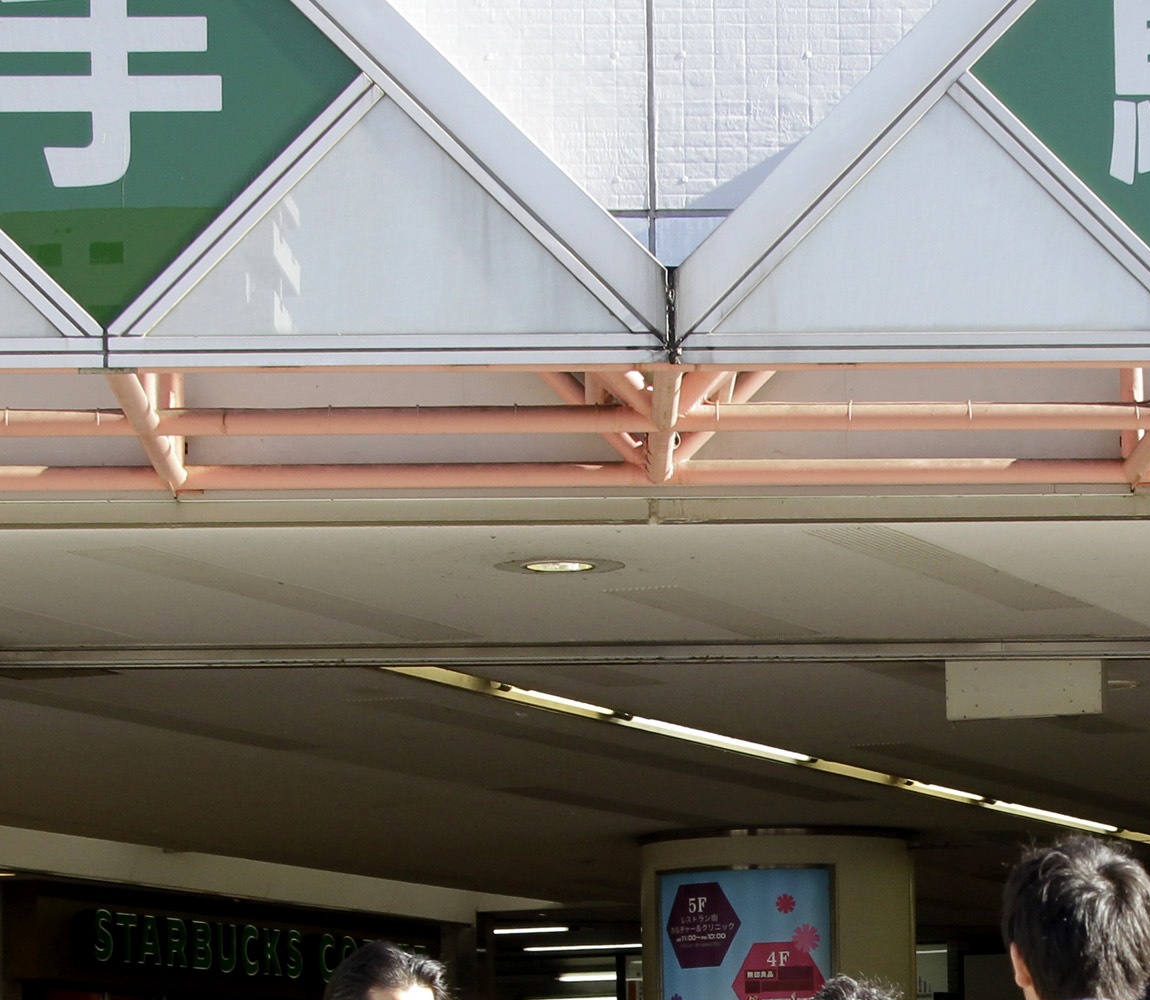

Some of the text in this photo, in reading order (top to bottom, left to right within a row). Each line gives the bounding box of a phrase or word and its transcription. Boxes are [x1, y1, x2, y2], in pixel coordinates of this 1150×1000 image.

[688, 897, 707, 914] 5F
[94, 908, 303, 979] STARBUCKS
[766, 951, 790, 966] 4F
